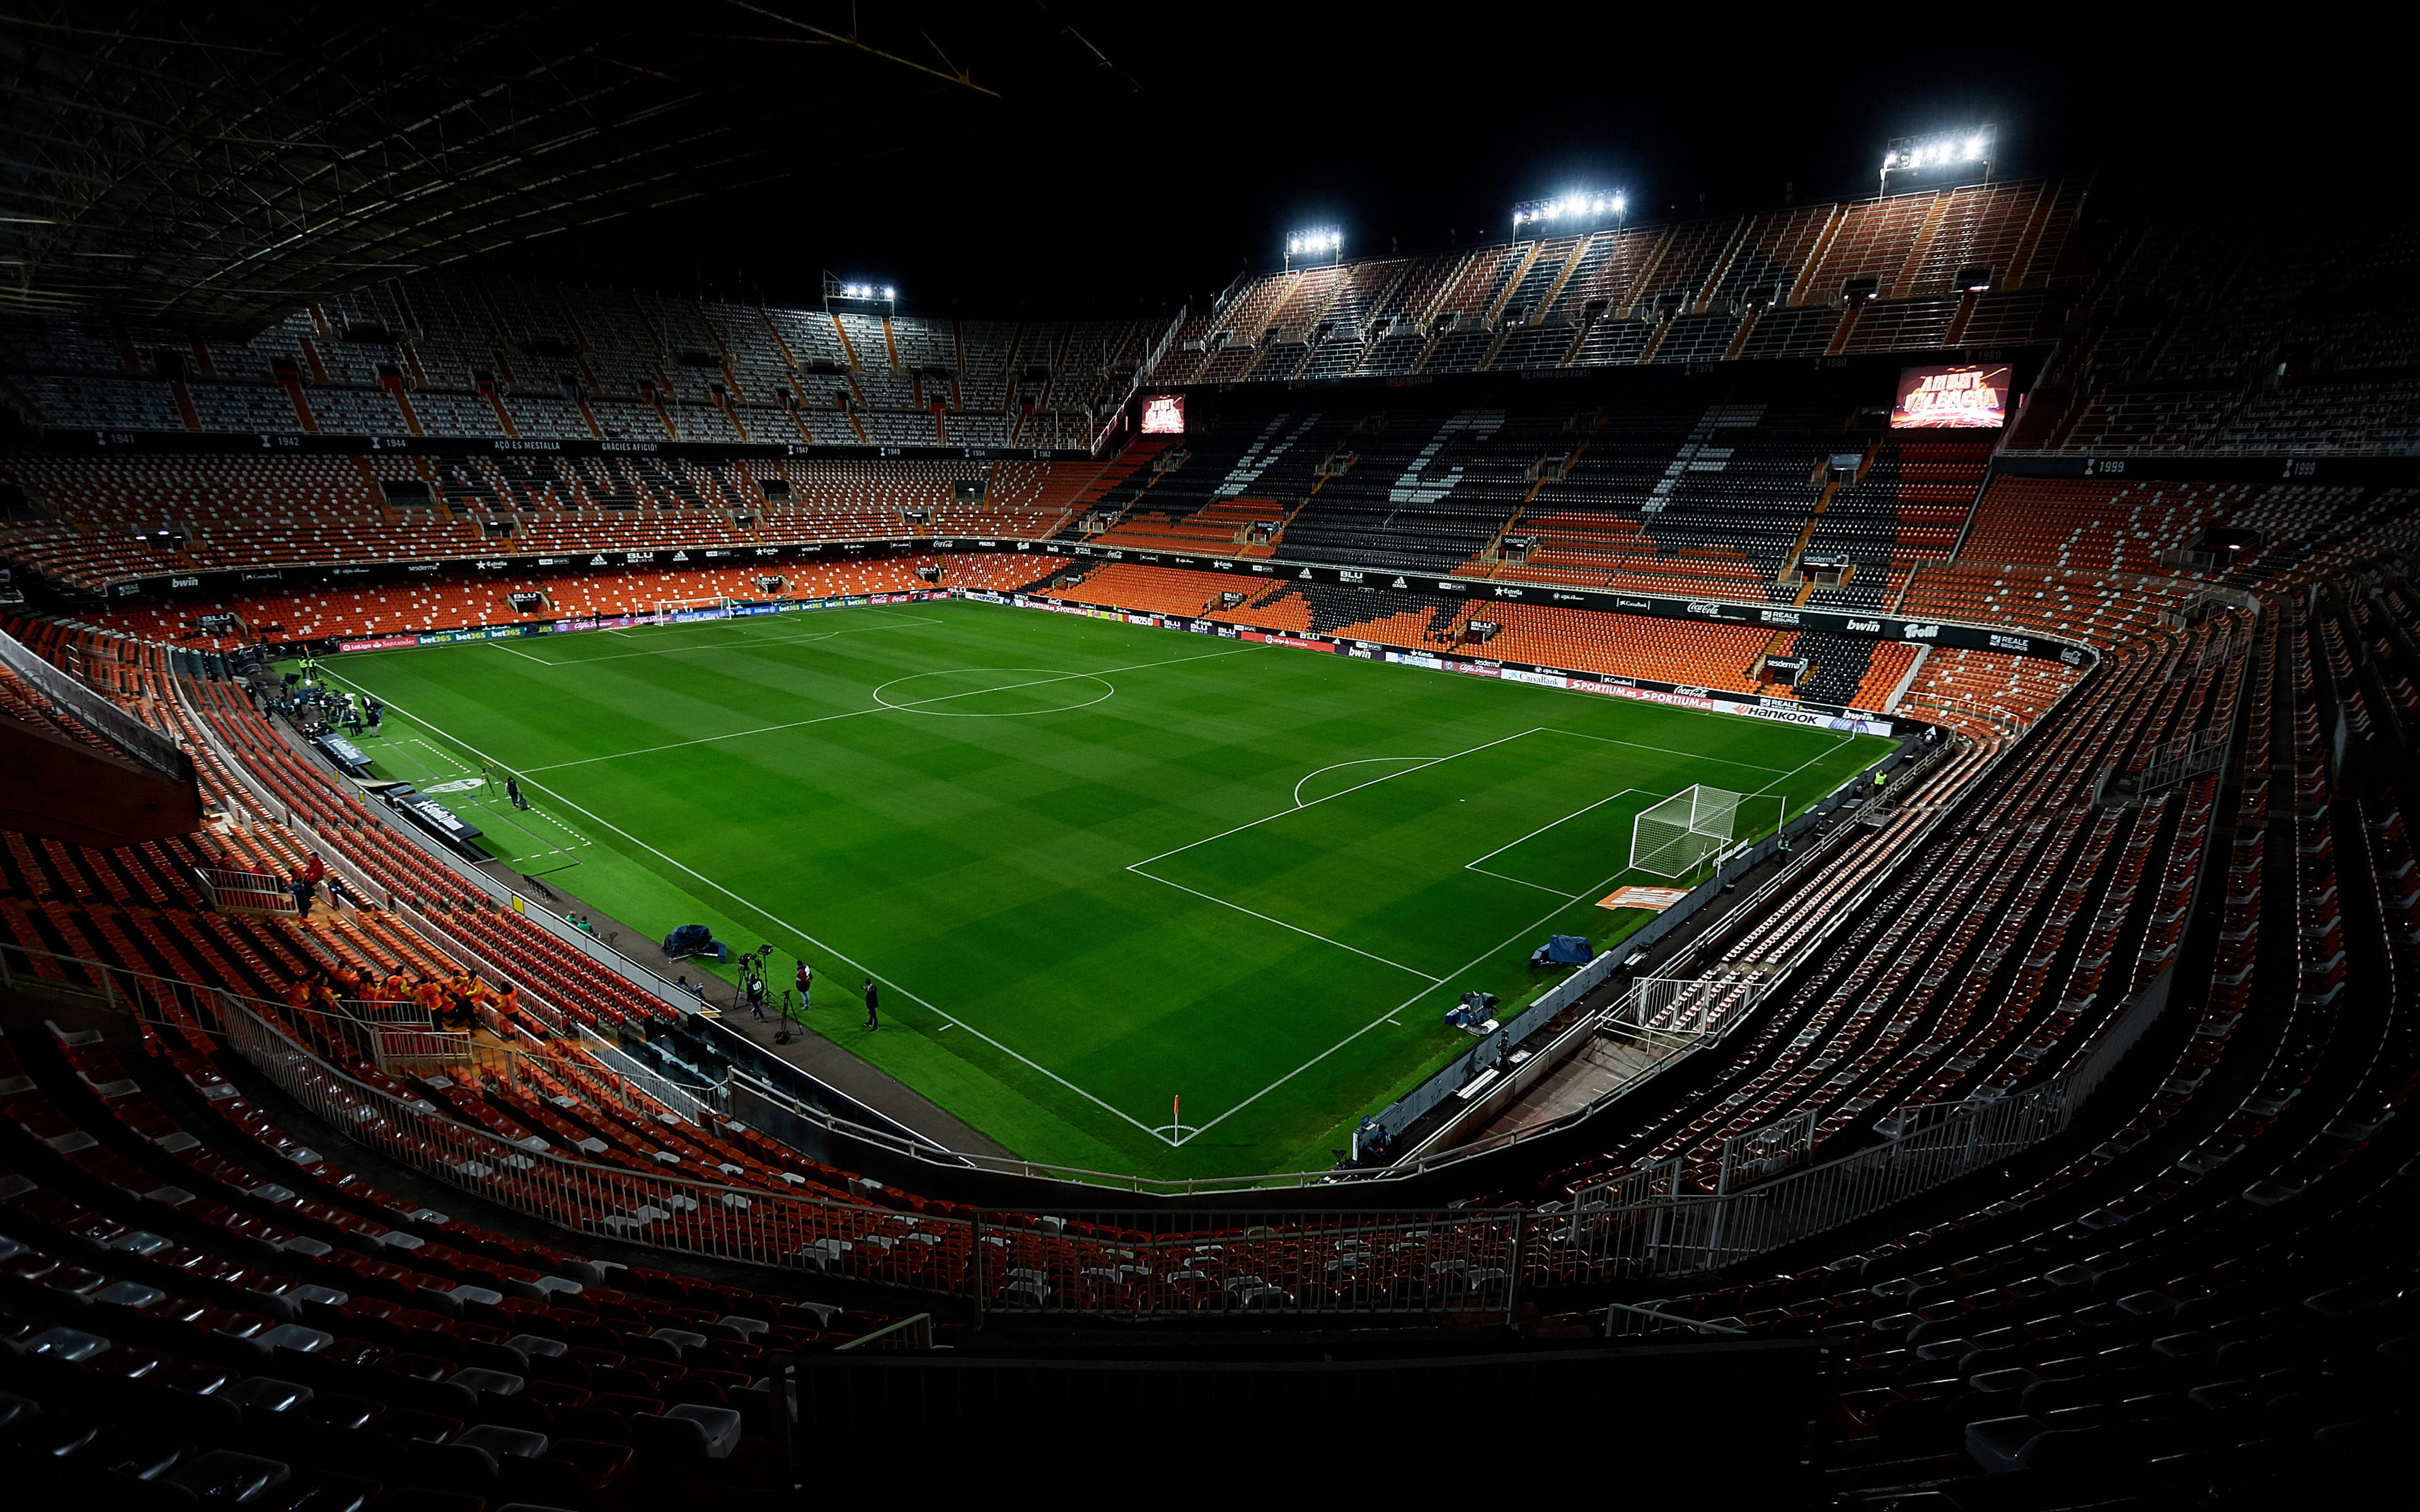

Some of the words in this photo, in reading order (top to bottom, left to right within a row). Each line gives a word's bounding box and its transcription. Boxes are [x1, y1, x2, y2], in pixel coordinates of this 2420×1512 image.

[1826, 357, 1847, 367] 1980
[1921, 371, 1983, 392] AMUNT
[111, 435, 134, 444] 1941
[278, 437, 299, 446] 1942
[386, 439, 406, 448] 1944
[524, 442, 560, 450] MESTALLA
[2099, 461, 2124, 472] 1999
[1804, 555, 1837, 563] sesderma
[408, 564, 437, 572] sesderma
[1340, 571, 1363, 579] BLU
[172, 576, 199, 588] bwin
[202, 614, 230, 622] BLU
[574, 621, 589, 630] Alfa
[1846, 619, 1881, 632] bwin
[491, 629, 521, 638] bet365
[1218, 627, 1236, 635] BLU
[1904, 624, 1939, 639] Trolli
[420, 635, 451, 644] bet365
[456, 632, 486, 641] bet365
[2002, 636, 2029, 646] REALE
[382, 638, 415, 647] Santander
[1349, 646, 1372, 659] bwin
[1474, 659, 1500, 668] sesderma
[1767, 660, 1800, 669] sesderma
[1459, 663, 1476, 673] Alfa
[1475, 665, 1499, 675] Romeo
[1519, 673, 1559, 686] CaixaBank
[1610, 677, 1633, 686] CaixaBank
[1568, 680, 1637, 698] SPORTIUM.es
[1636, 690, 1712, 709] SPORTIUM.es
[1772, 699, 1799, 708] REALE
[1843, 709, 1875, 721] bwin
